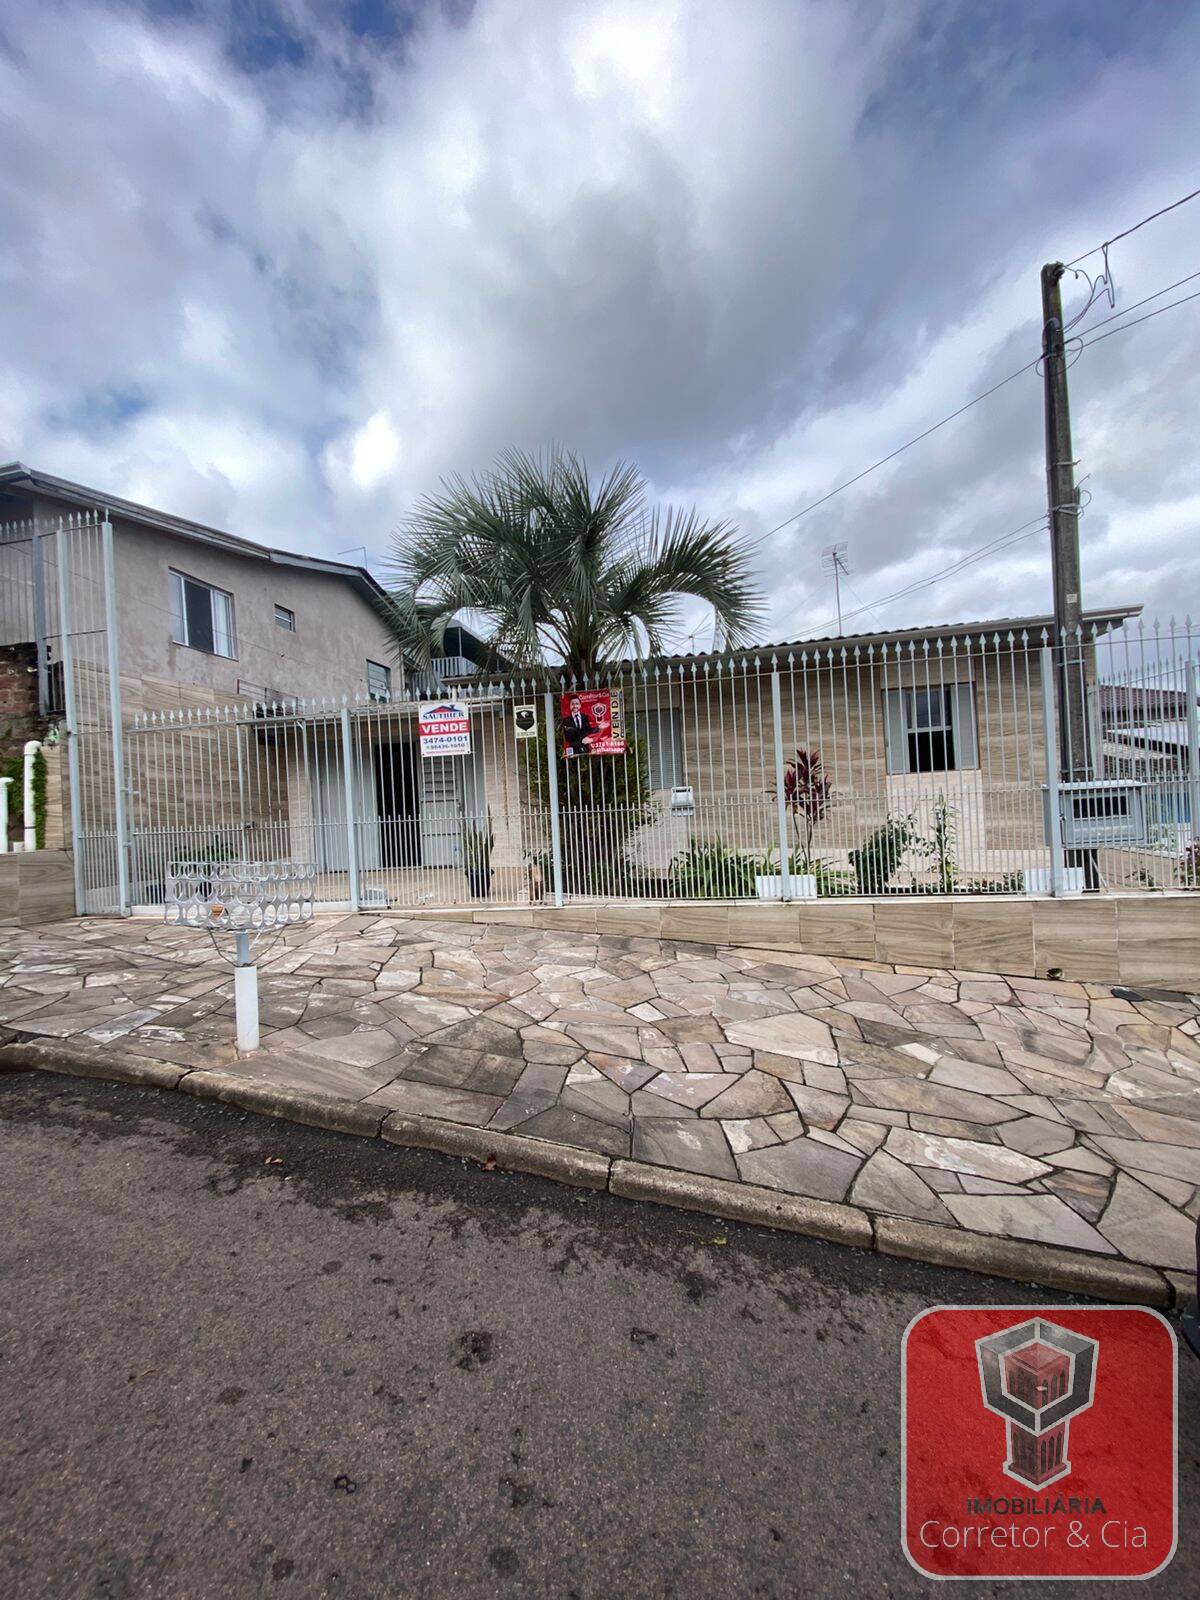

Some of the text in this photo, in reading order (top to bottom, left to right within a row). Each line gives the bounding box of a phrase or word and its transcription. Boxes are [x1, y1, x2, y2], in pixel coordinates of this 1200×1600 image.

[423, 711, 464, 720] SAUTHIER
[611, 690, 620, 738] VENDE
[421, 721, 468, 734] VENDE
[423, 735, 468, 744] 3474-0101
